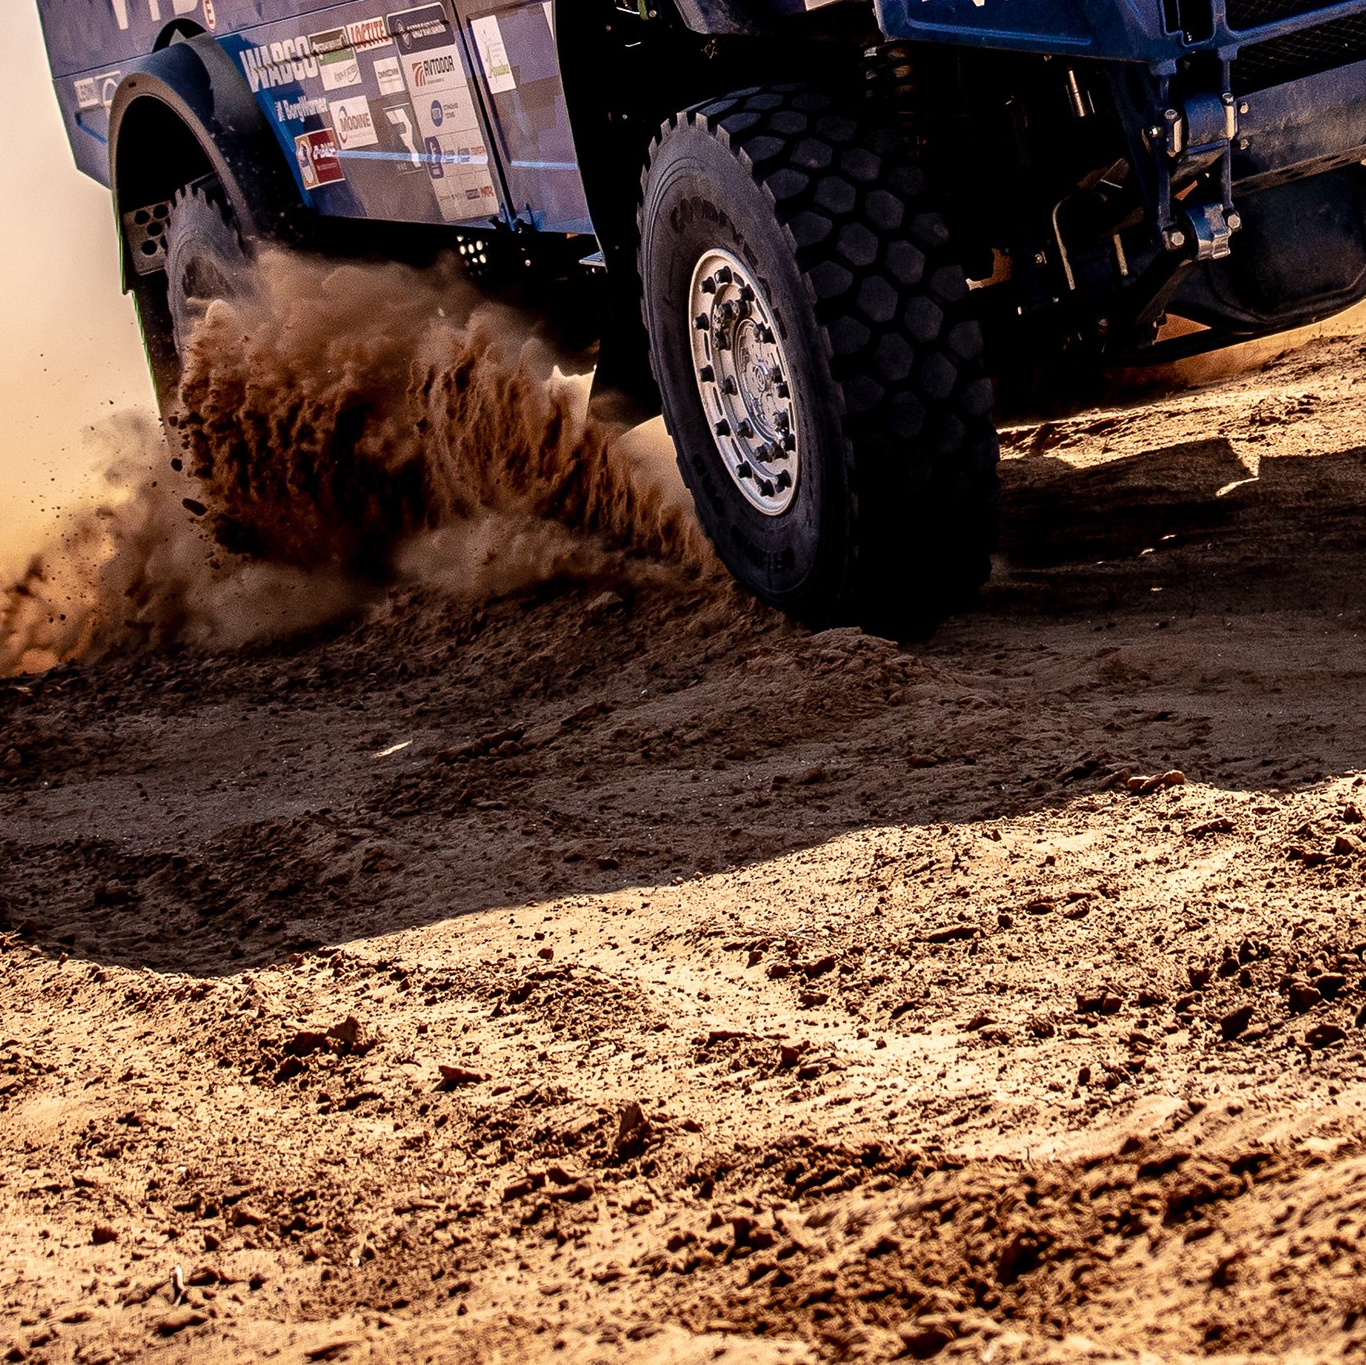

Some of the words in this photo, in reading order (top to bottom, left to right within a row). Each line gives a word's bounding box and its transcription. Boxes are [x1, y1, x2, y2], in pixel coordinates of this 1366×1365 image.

[239, 36, 319, 93] WABCO
[423, 55, 455, 76] AVTODOR
[339, 113, 371, 132] MODINE
